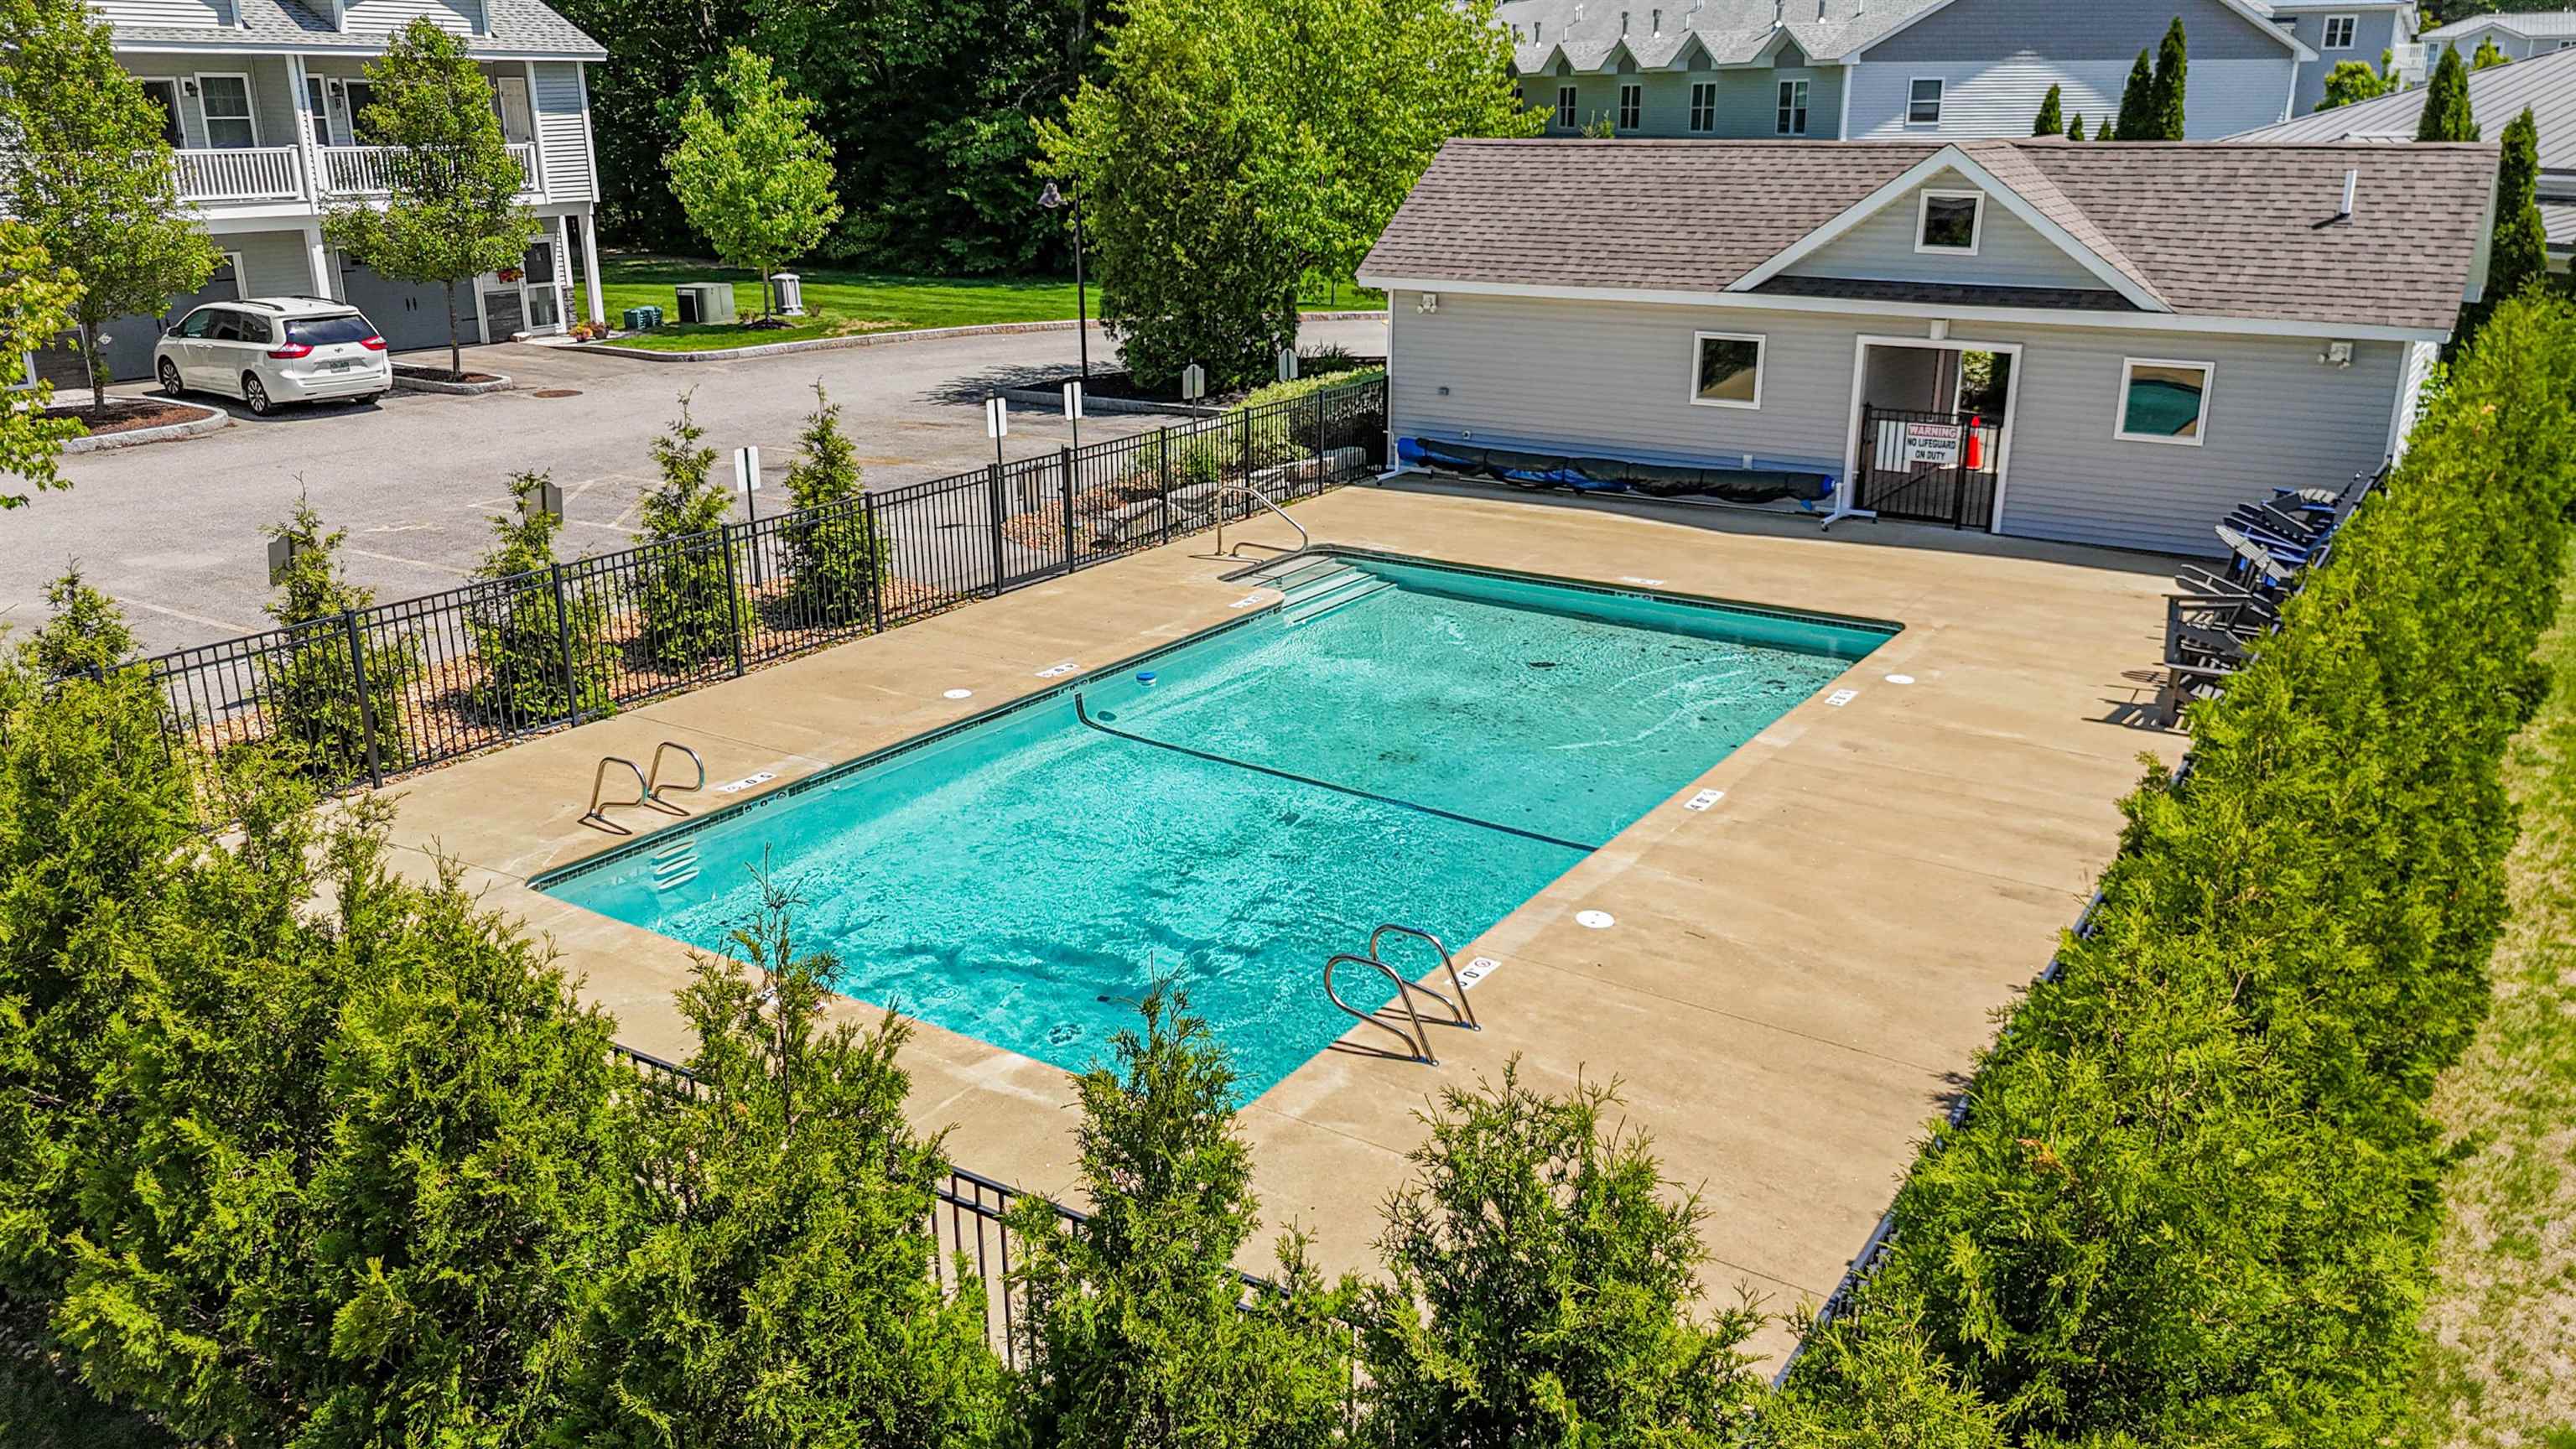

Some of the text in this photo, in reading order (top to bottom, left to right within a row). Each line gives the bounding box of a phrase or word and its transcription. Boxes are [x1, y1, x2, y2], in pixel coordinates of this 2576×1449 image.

[1909, 426, 1956, 438] WARNING
[1908, 438, 1955, 449] NO LIFEGUARD
[1915, 450, 1945, 460] ON DUTY
